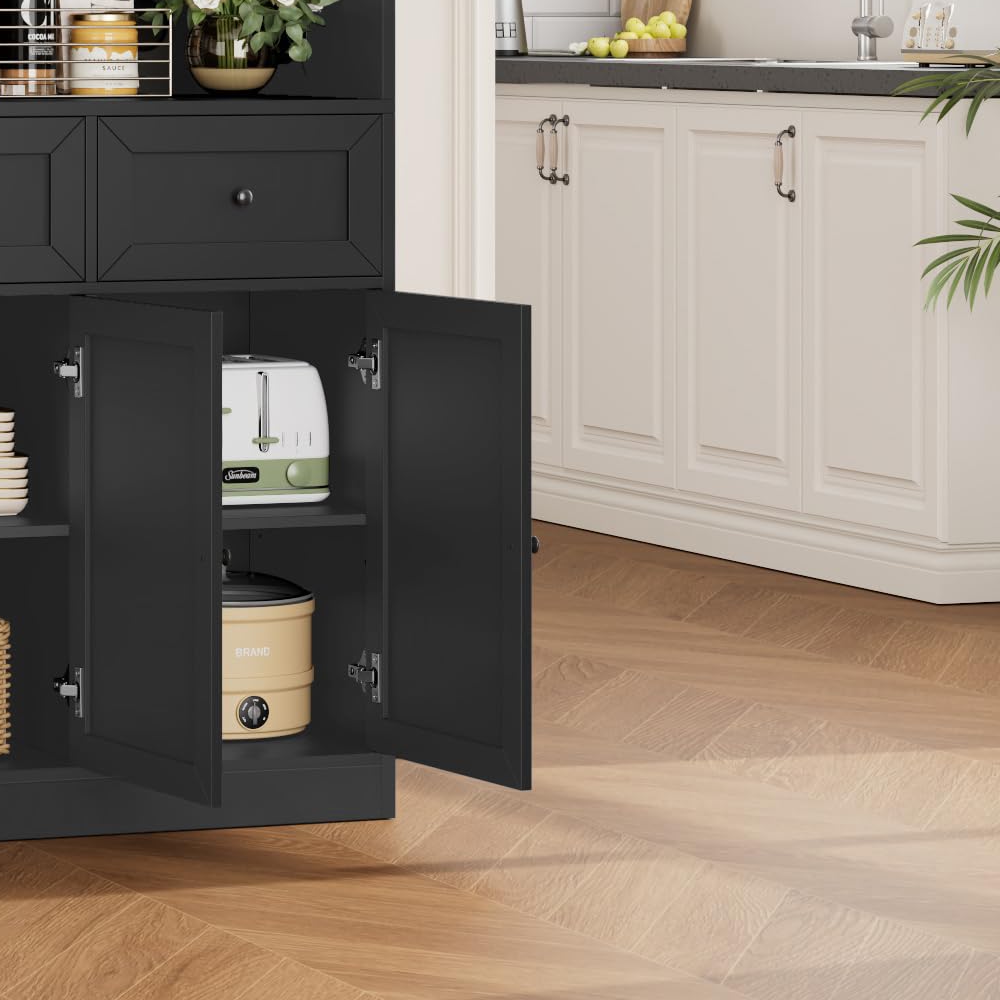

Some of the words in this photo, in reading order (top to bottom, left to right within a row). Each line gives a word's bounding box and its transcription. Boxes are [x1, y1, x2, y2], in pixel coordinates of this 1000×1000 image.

[27, 33, 48, 41] COCOA
[224, 469, 258, 481] Sunbeam
[234, 647, 271, 658] BRAND
